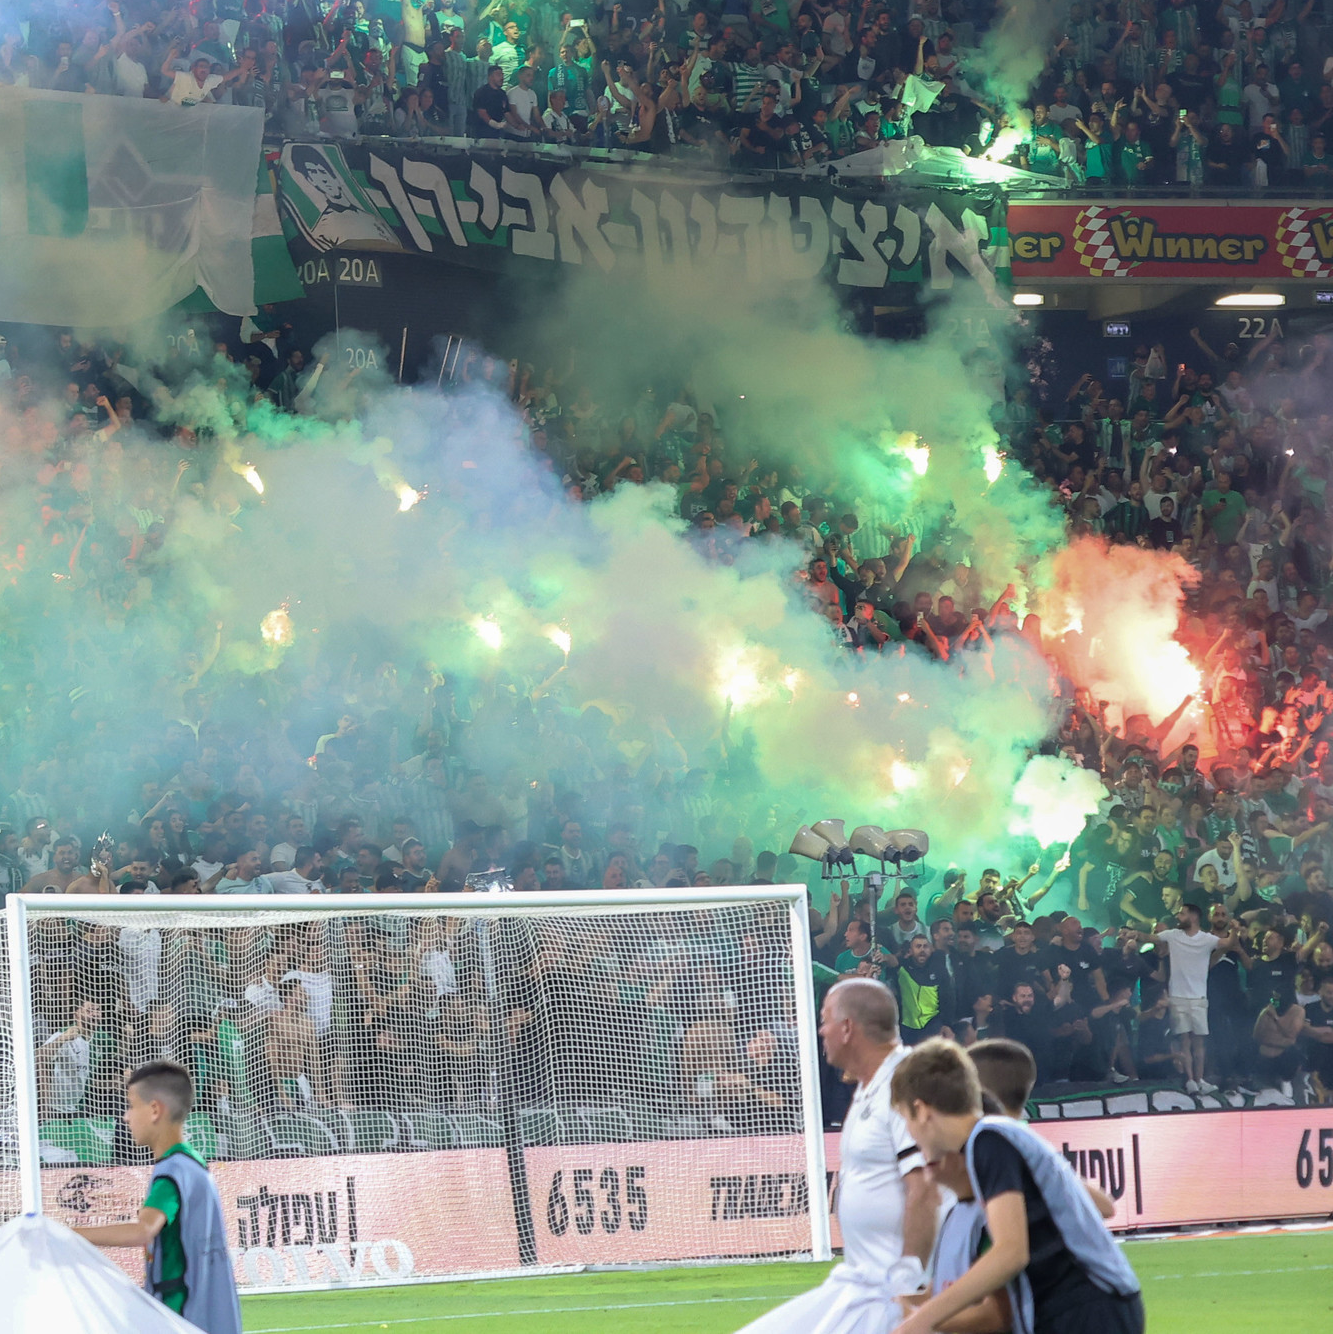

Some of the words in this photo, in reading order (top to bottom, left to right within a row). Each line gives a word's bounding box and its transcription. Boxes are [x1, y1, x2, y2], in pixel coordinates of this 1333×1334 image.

[369, 152, 617, 274] אבירן
[1109, 217, 1264, 260] Winner
[339, 257, 379, 283] 20A
[1238, 318, 1284, 338] 22A
[346, 348, 379, 370] 20A
[546, 1166, 647, 1236] 6535
